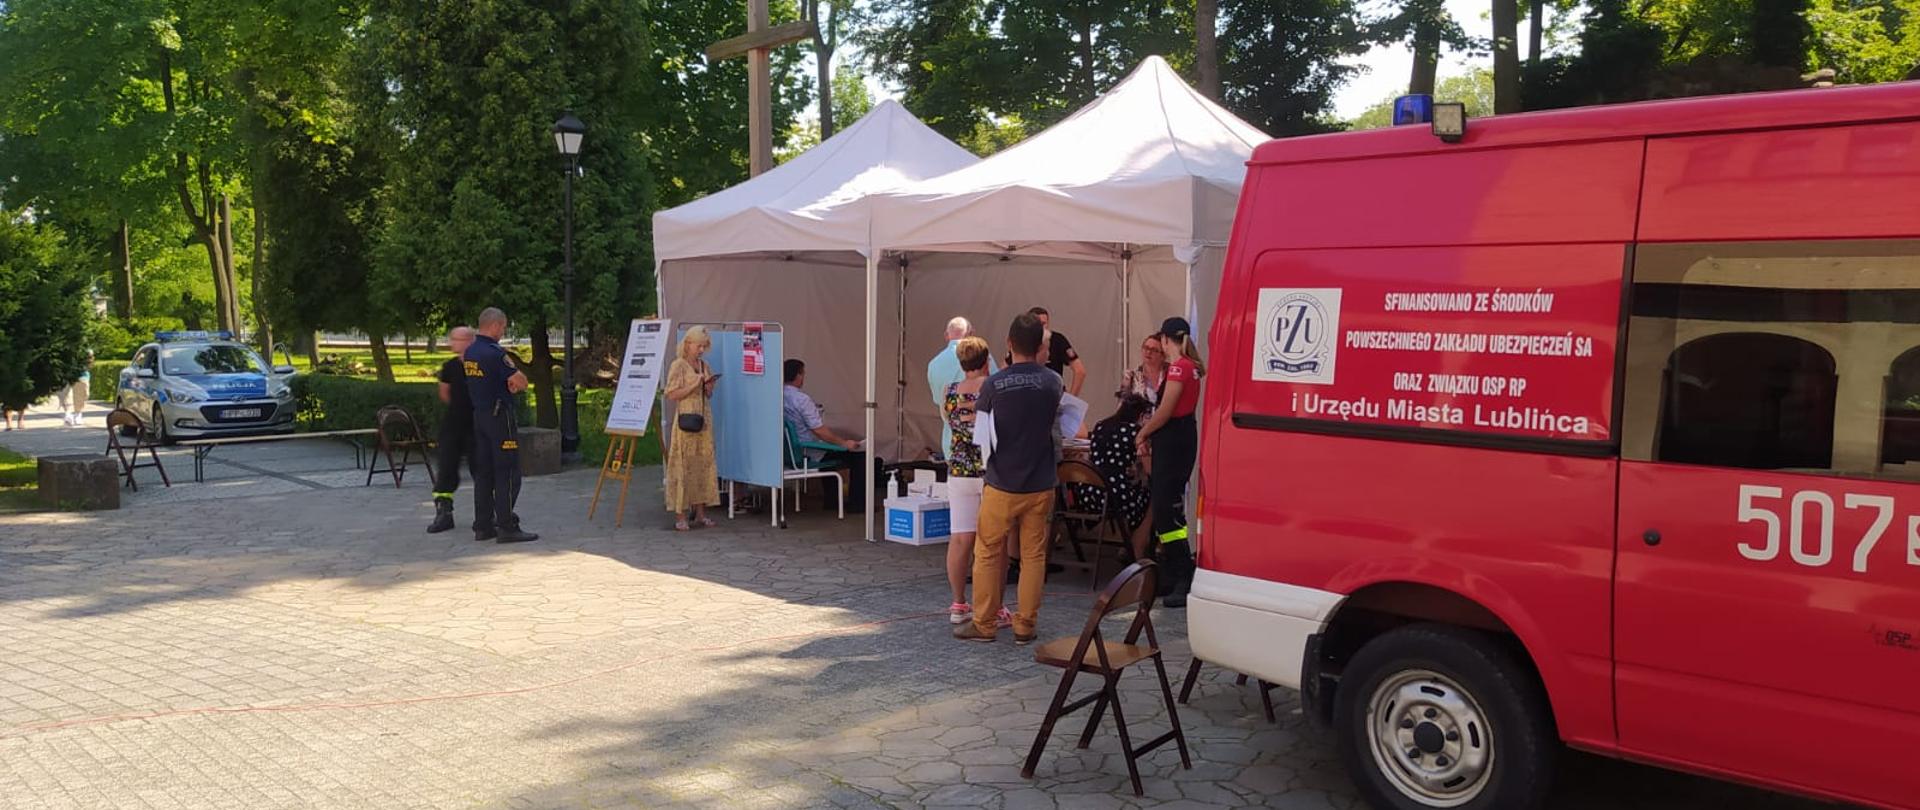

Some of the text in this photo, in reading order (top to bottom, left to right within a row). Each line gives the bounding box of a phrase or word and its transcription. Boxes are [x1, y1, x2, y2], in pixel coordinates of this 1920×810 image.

[1385, 288, 1553, 313] SFINANSOWANO ZE ŚRODKÓW
[1276, 305, 1319, 353] PZU
[1346, 331, 1592, 357] POWSZECHNEGO ZAKŁADU UBEZPIECZEŃ SA
[1393, 372, 1526, 397] ORAZ ZWIĄZKU OSP RP
[1291, 393, 1588, 434] i Urzędu Miasta Lublińca
[1737, 484, 1895, 573] 507
